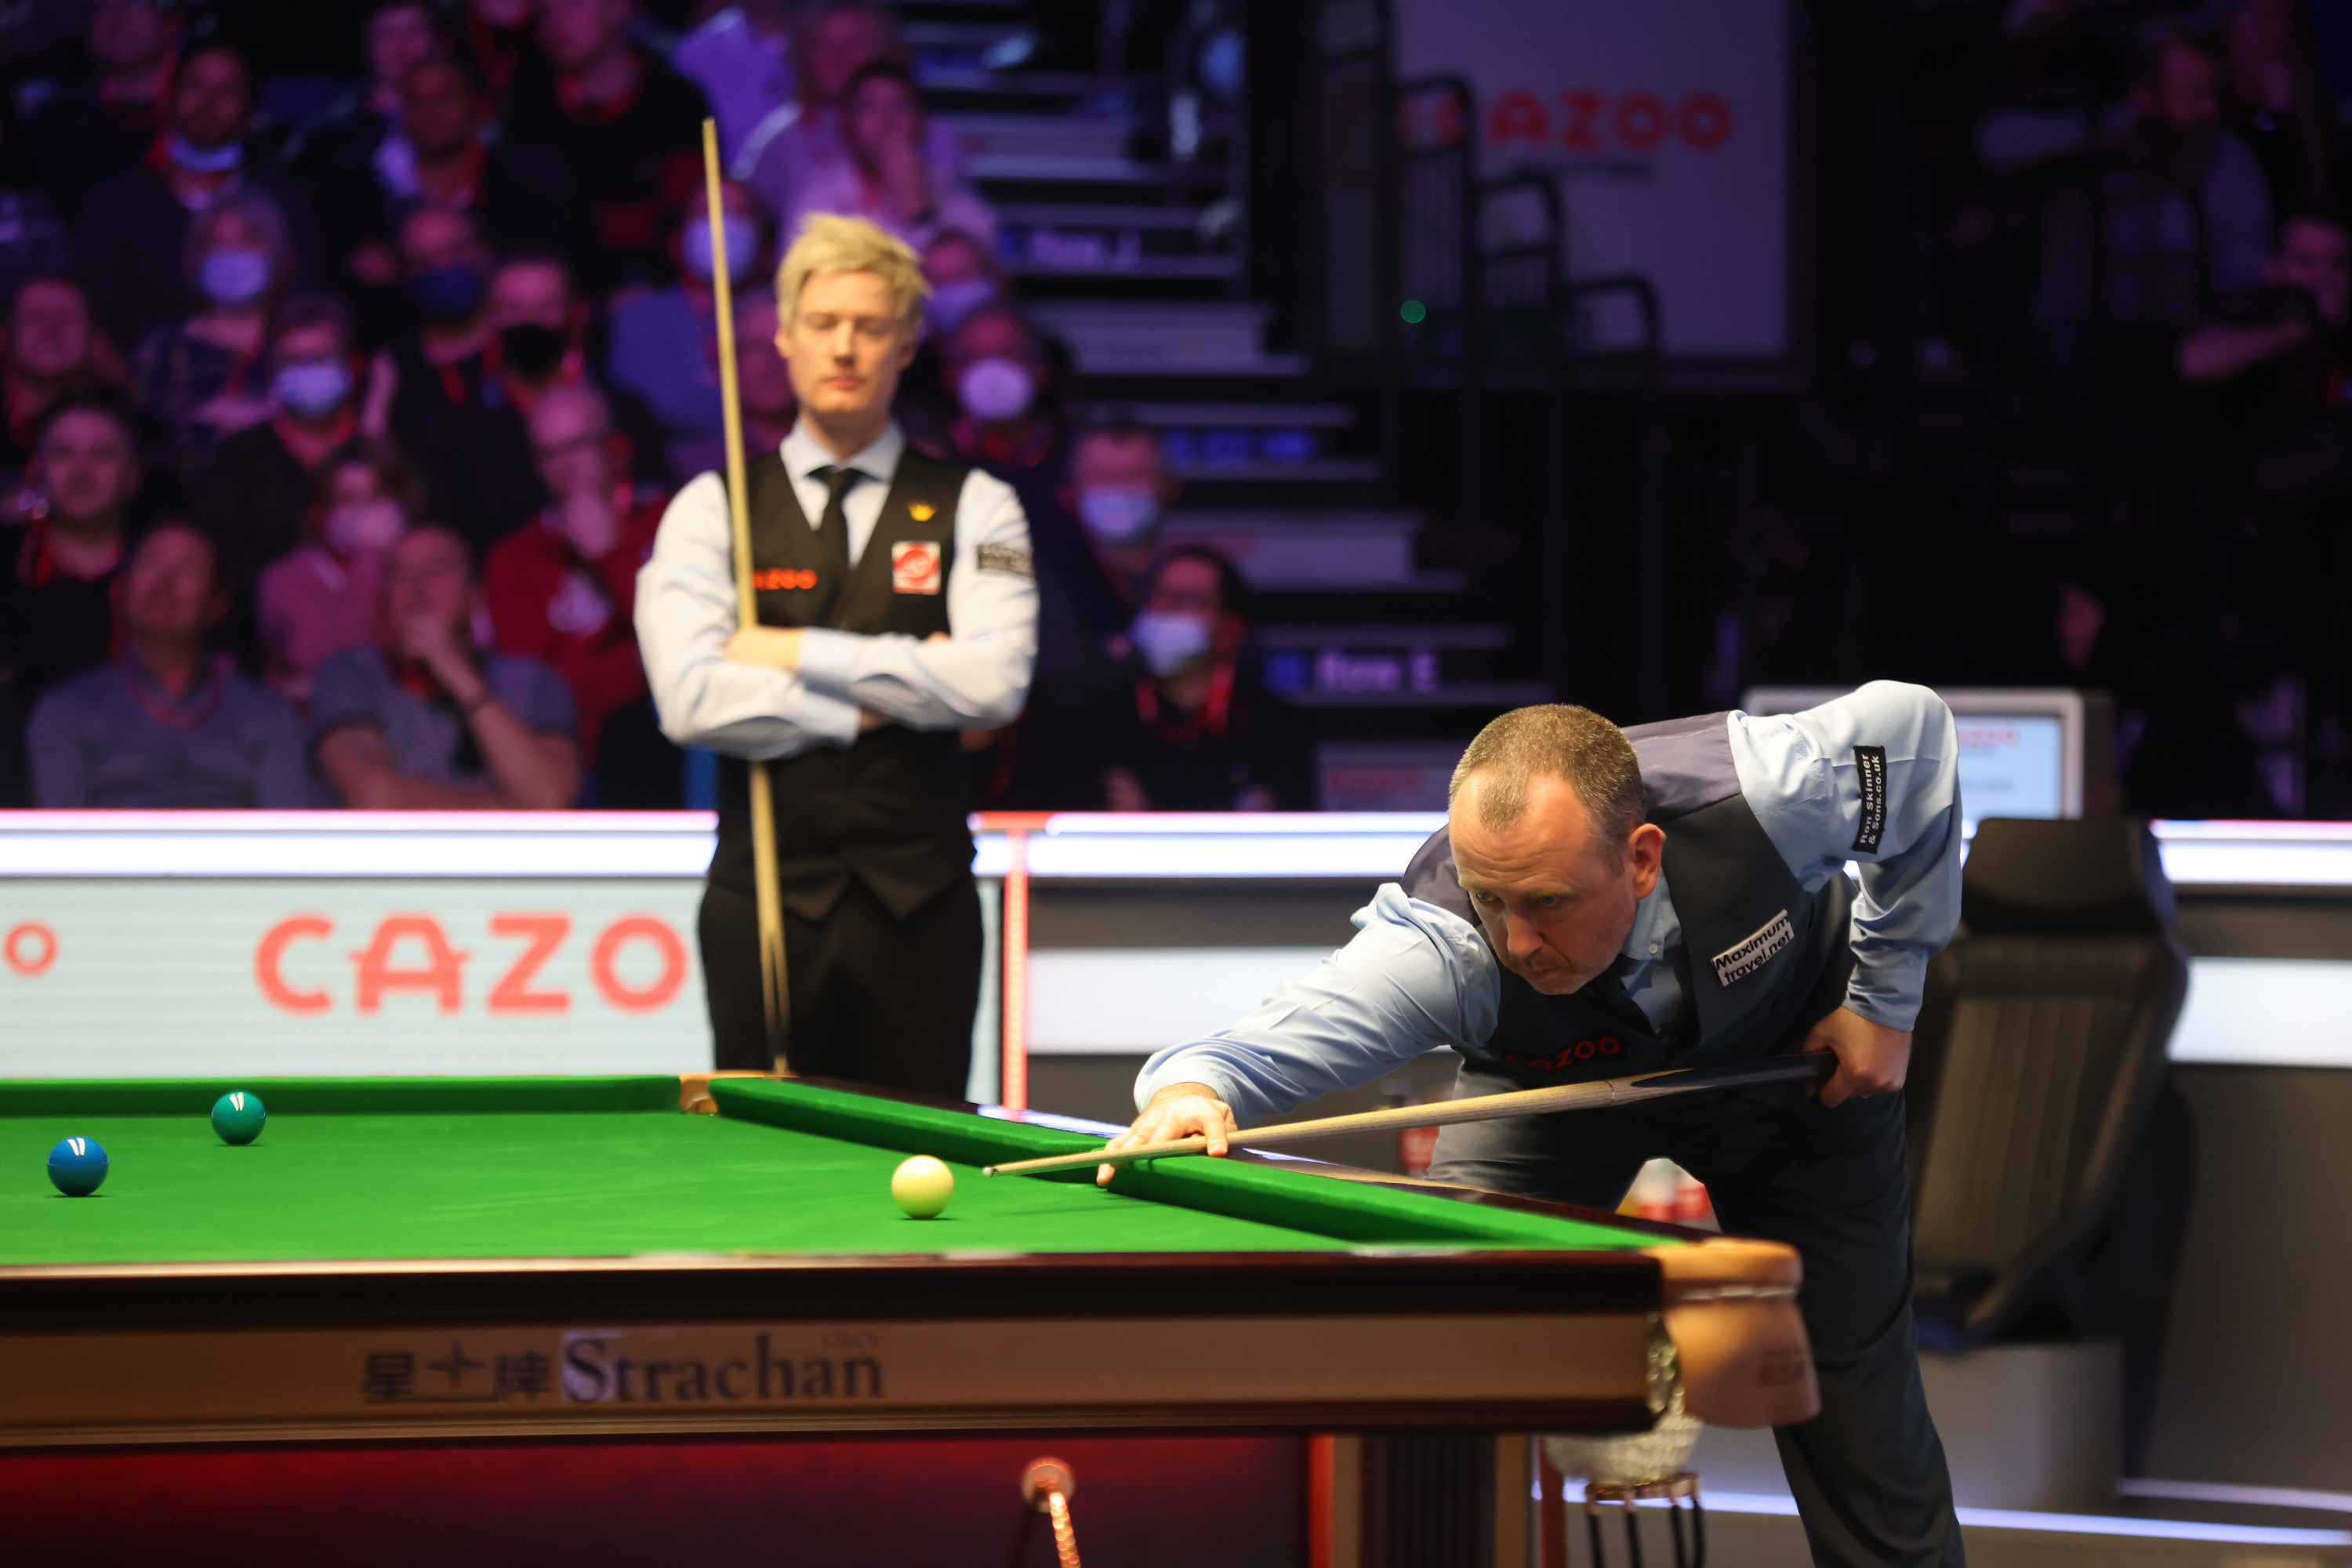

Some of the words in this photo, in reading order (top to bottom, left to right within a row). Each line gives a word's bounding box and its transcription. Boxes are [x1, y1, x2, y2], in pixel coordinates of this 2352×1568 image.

[1862, 753, 1874, 811] Skinner
[1871, 755, 1882, 829] Sons.co.uk
[1860, 816, 1872, 844] Ron
[1868, 835, 1877, 844] &
[254, 913, 688, 1017] CAZO
[1715, 916, 1788, 971] Maximum
[1724, 931, 1791, 982] travel.net
[564, 1332, 885, 1402] Strachan
